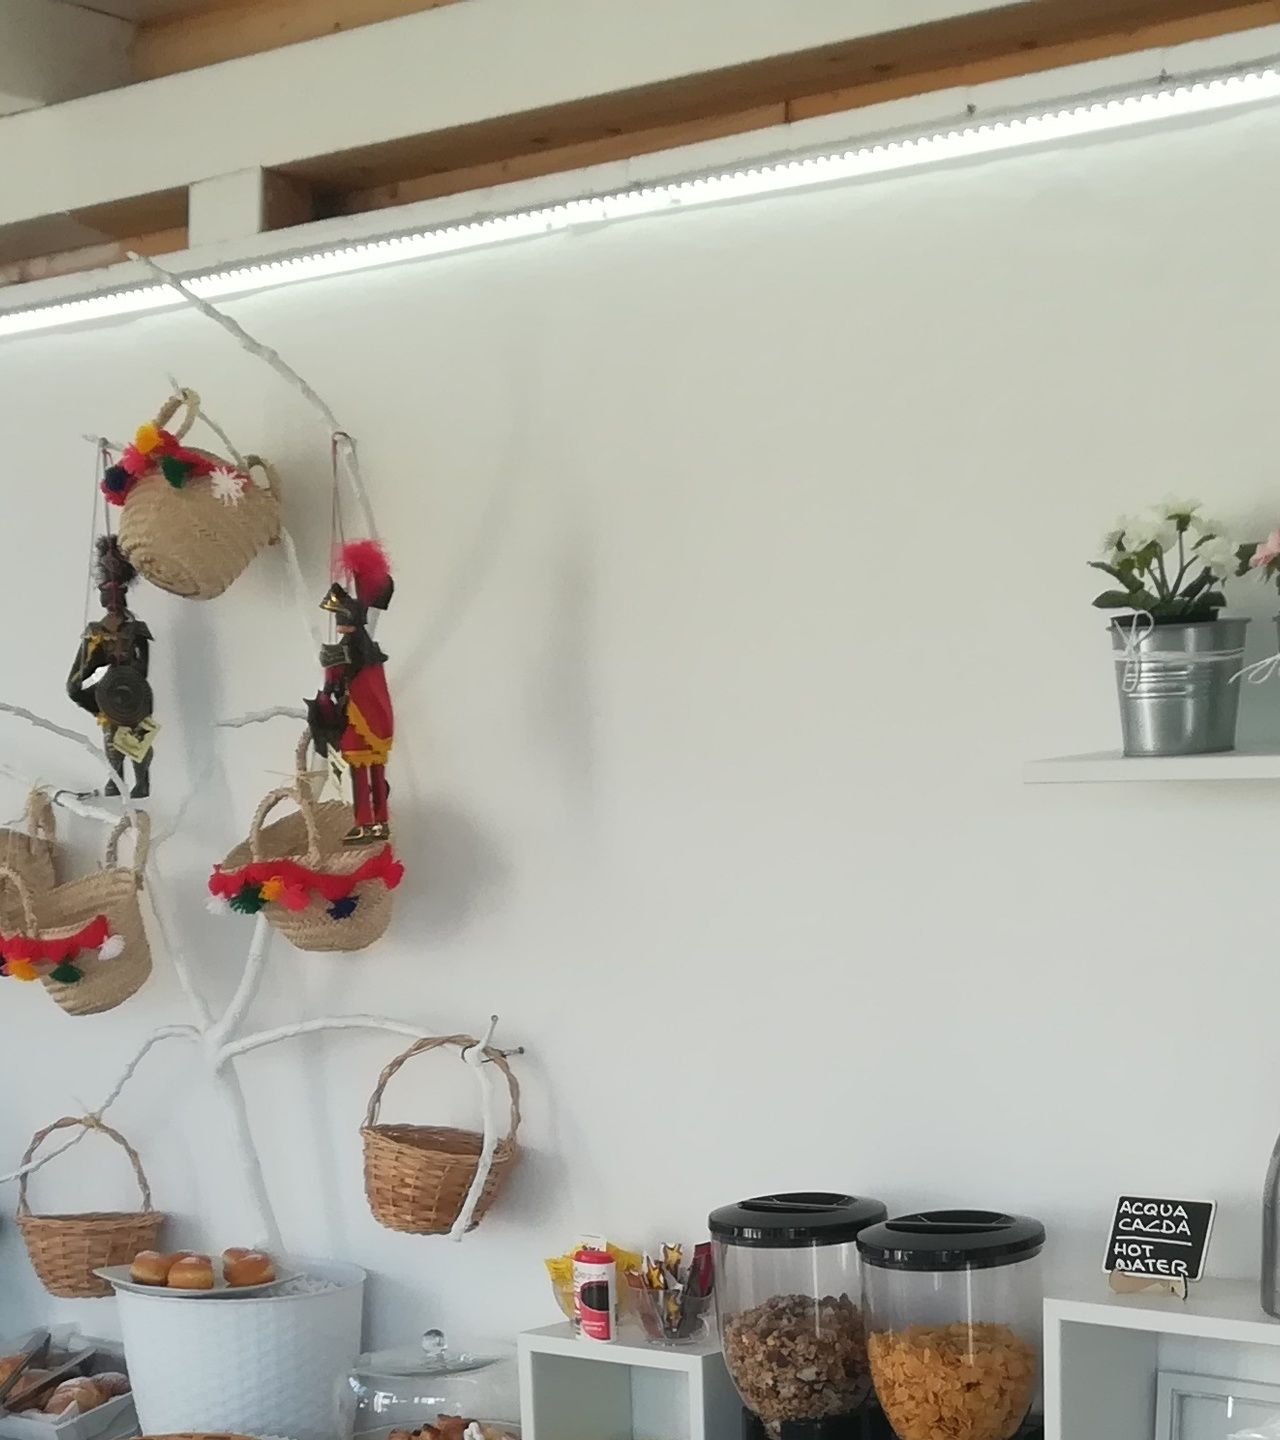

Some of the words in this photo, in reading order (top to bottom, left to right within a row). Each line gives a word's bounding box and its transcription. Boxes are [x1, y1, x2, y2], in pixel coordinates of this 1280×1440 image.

[1119, 1200, 1189, 1220] ACQUA
[1118, 1218, 1192, 1236] CALDA
[1113, 1242, 1154, 1258] HOT
[1115, 1258, 1189, 1276] WATER
